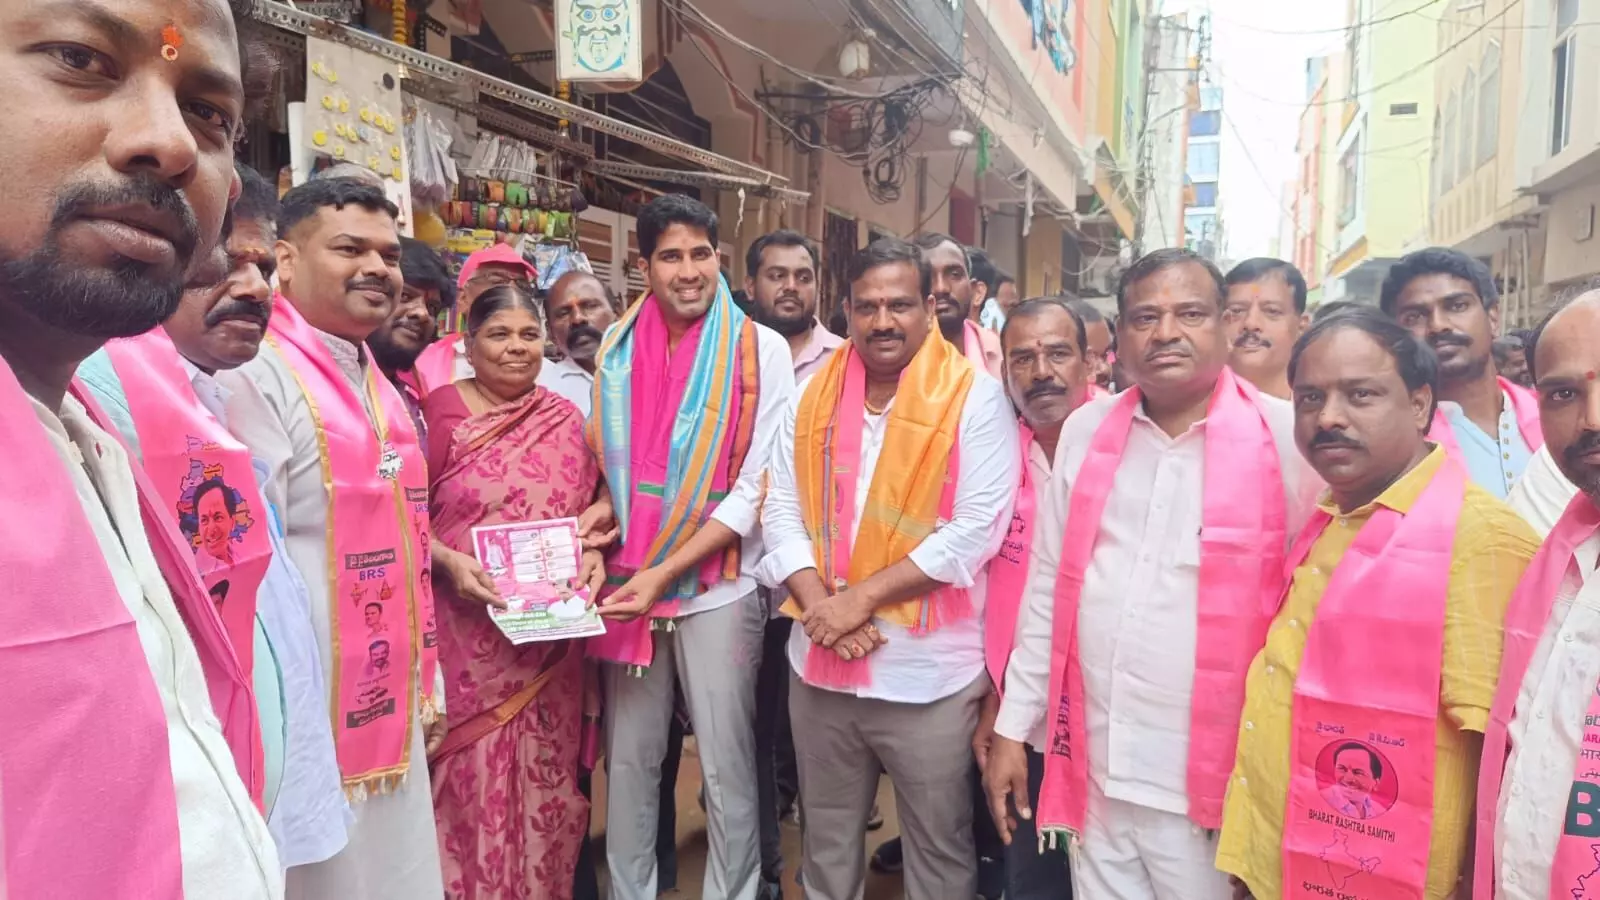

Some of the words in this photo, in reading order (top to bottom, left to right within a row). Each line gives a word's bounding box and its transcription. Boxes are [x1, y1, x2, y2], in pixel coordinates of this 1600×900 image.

[359, 567, 385, 580] BRS
[1308, 809, 1334, 824] BHARAT
[1335, 816, 1366, 835] RASHTRA
[1367, 825, 1396, 842] SAMITHI
